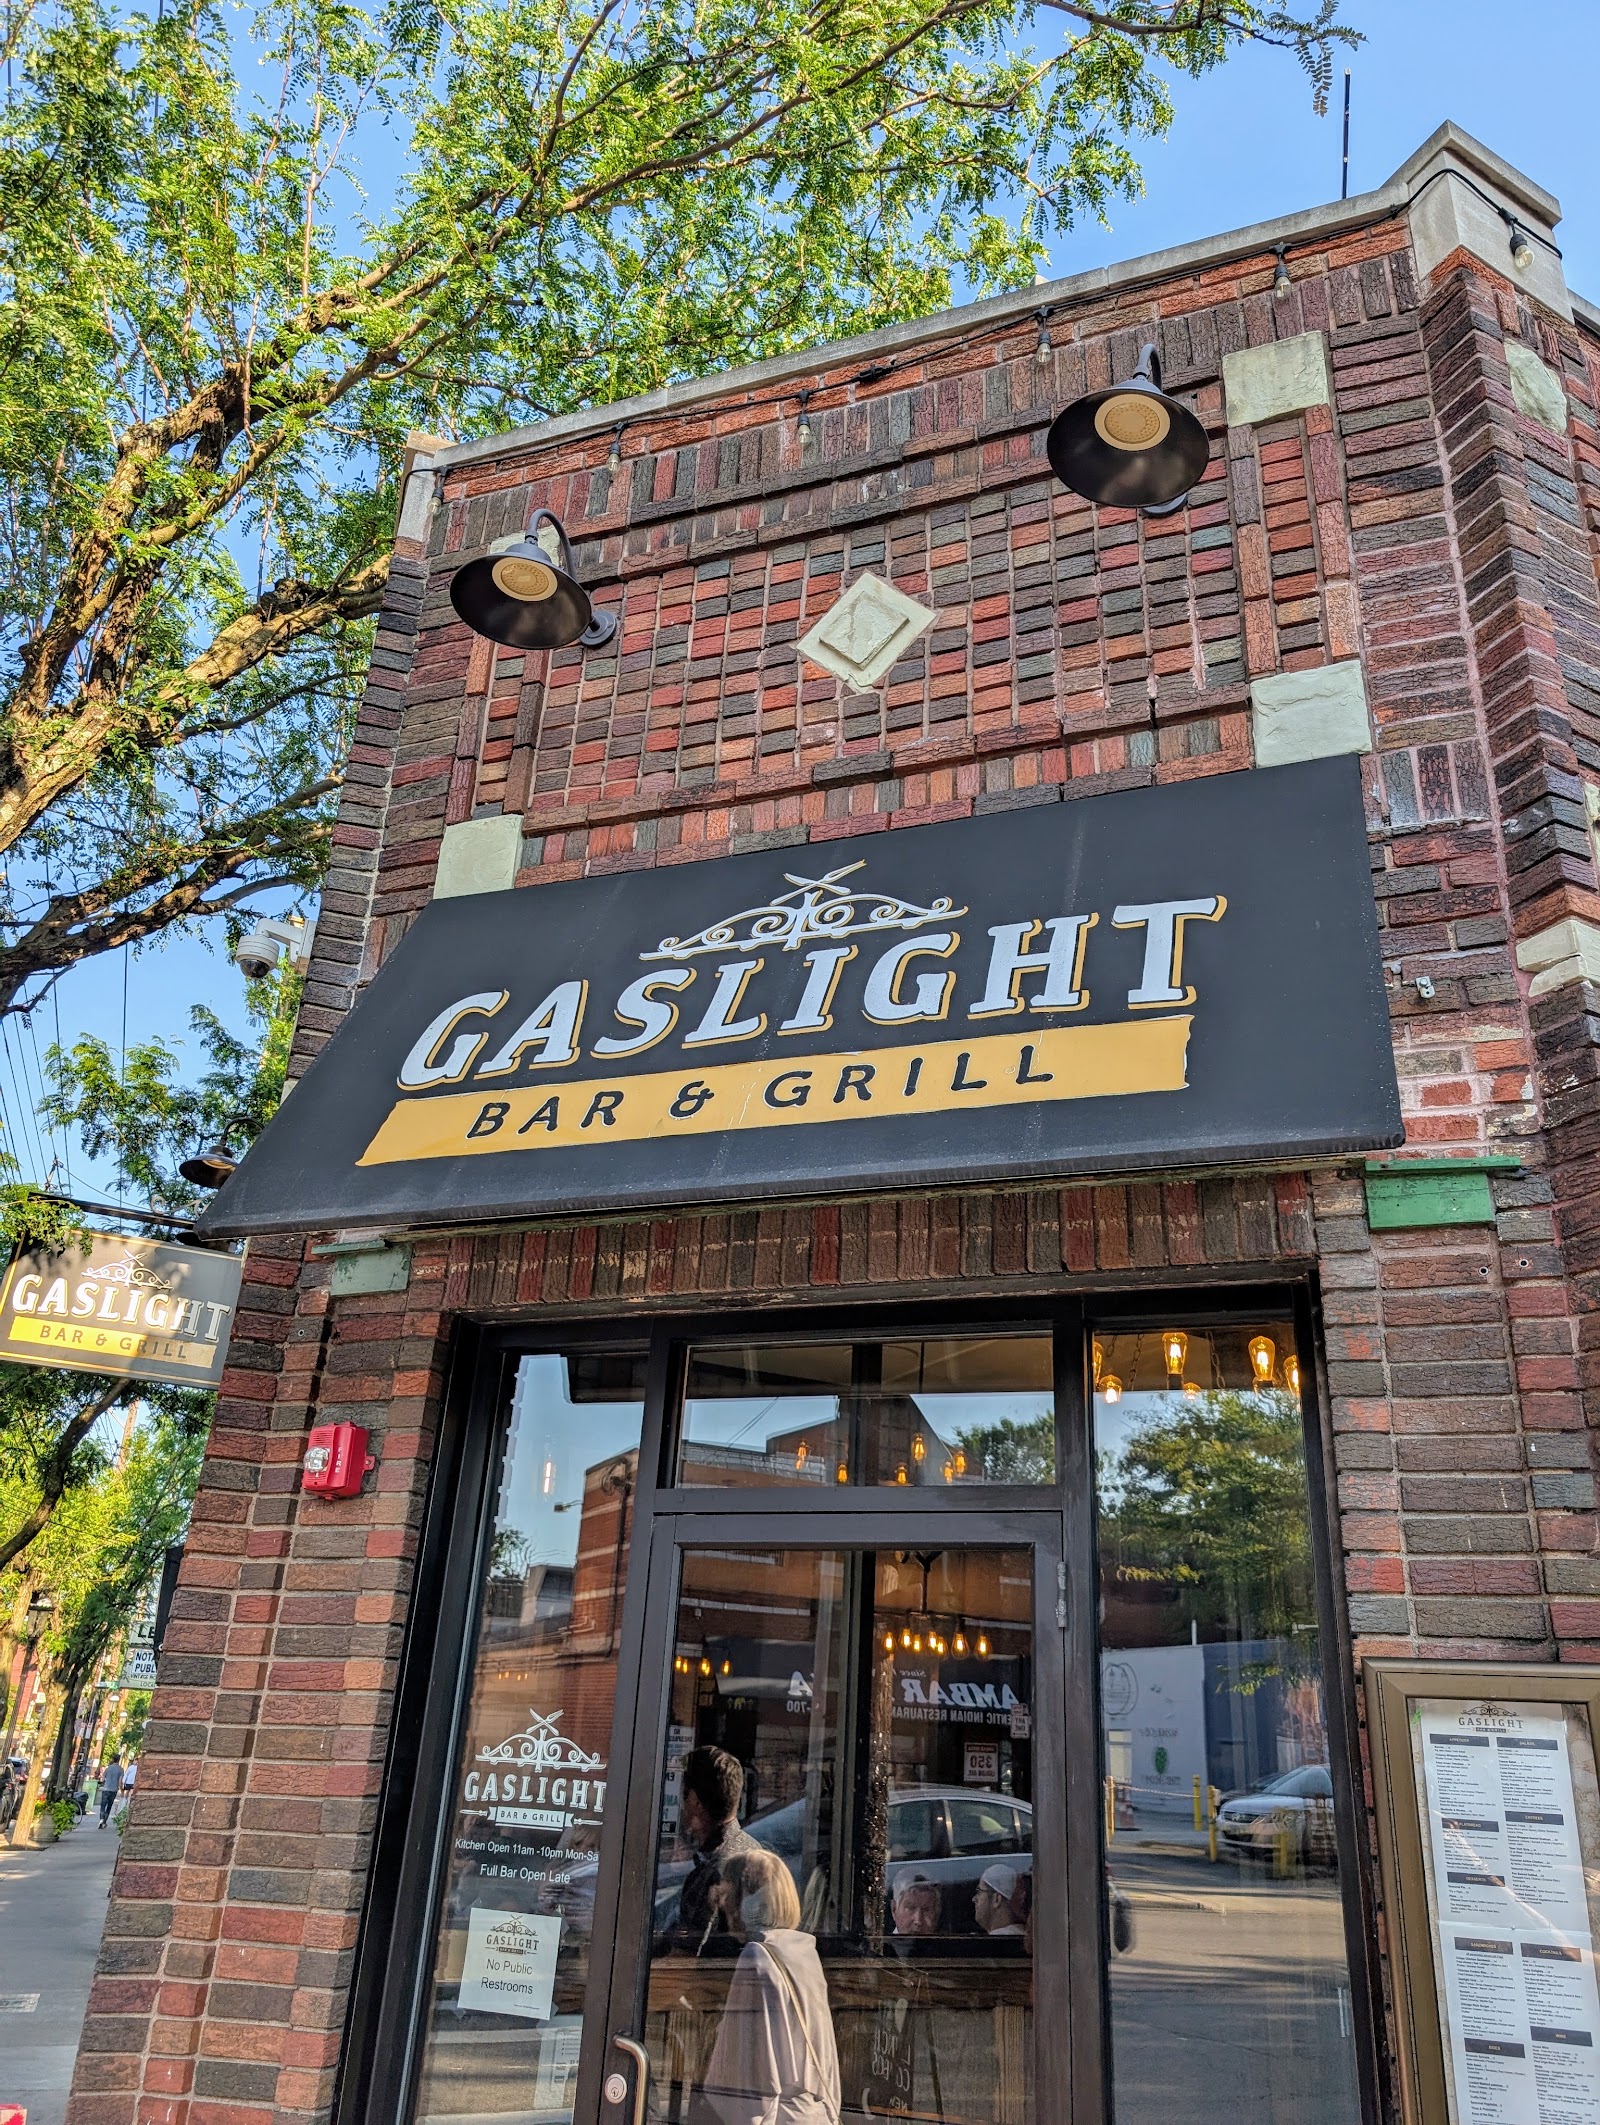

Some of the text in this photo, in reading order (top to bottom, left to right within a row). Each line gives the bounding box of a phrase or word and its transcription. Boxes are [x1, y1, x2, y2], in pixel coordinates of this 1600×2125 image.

[397, 895, 1227, 1090] GASLIGHT
[466, 1045, 1054, 1139] BAR & GRILL
[12, 1273, 232, 1343] GASLIGHT
[40, 1325, 187, 1359] BAR & GRILL
[335, 1446, 343, 1473] FIRE
[1458, 1716, 1524, 1730] GASLIGHT
[464, 1771, 607, 1813] GASLIGHT
[501, 1810, 561, 1823] BAR & GRILL
[455, 1838, 485, 1851] Kitchen
[487, 1841, 510, 1854] Open
[512, 1844, 535, 1855] 11am
[536, 1846, 564, 1859] -10pm
[480, 1863, 571, 1884] Full Bar Open Late
[486, 1934, 540, 1951] GASLIGHT
[486, 1958, 533, 1975] No Public
[481, 1976, 533, 1995] Restrooms
